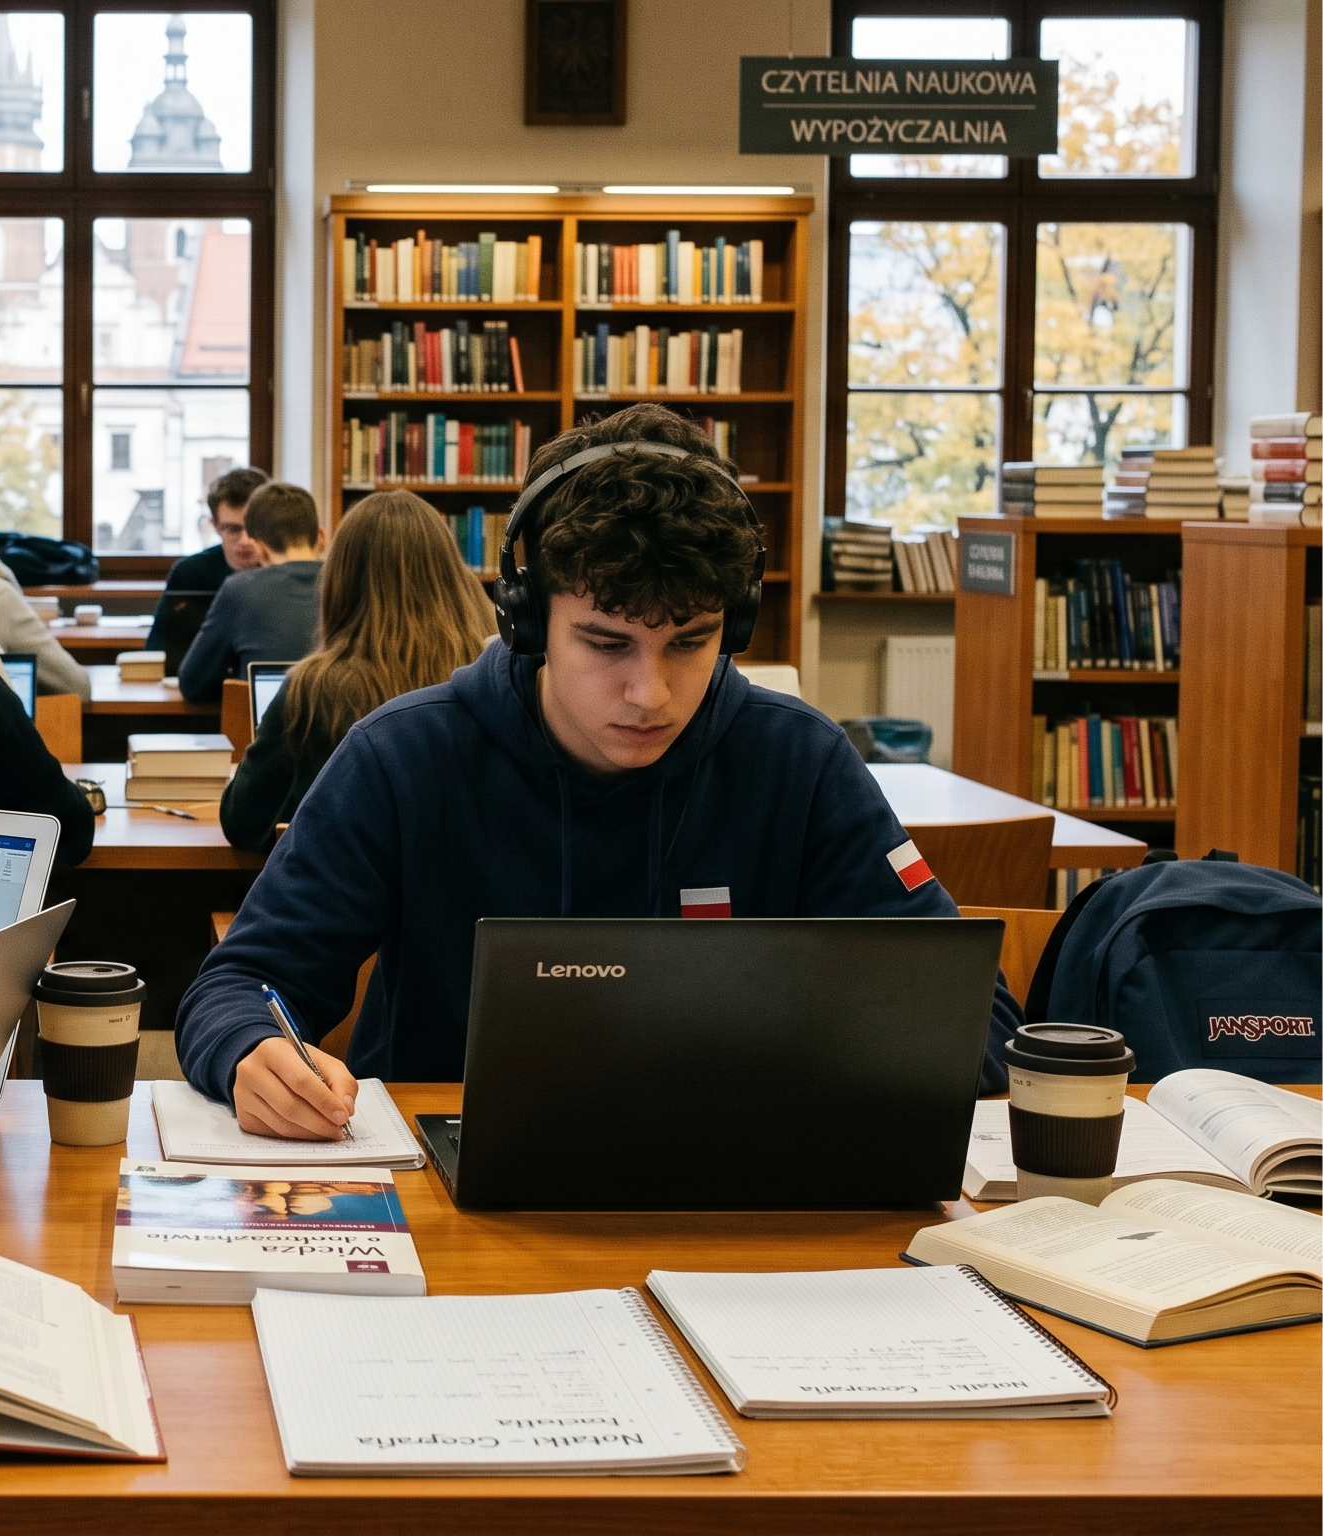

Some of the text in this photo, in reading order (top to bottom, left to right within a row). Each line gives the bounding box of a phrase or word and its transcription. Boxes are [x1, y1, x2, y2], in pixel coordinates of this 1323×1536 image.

[761, 69, 1037, 95] CZYTELNIA NAUKOWA
[790, 115, 1007, 144] WYPOŻYCZALNIA
[536, 961, 626, 978] Lenovo
[1208, 1014, 1314, 1042] JANSPORT
[261, 1245, 385, 1257] Wiedza
